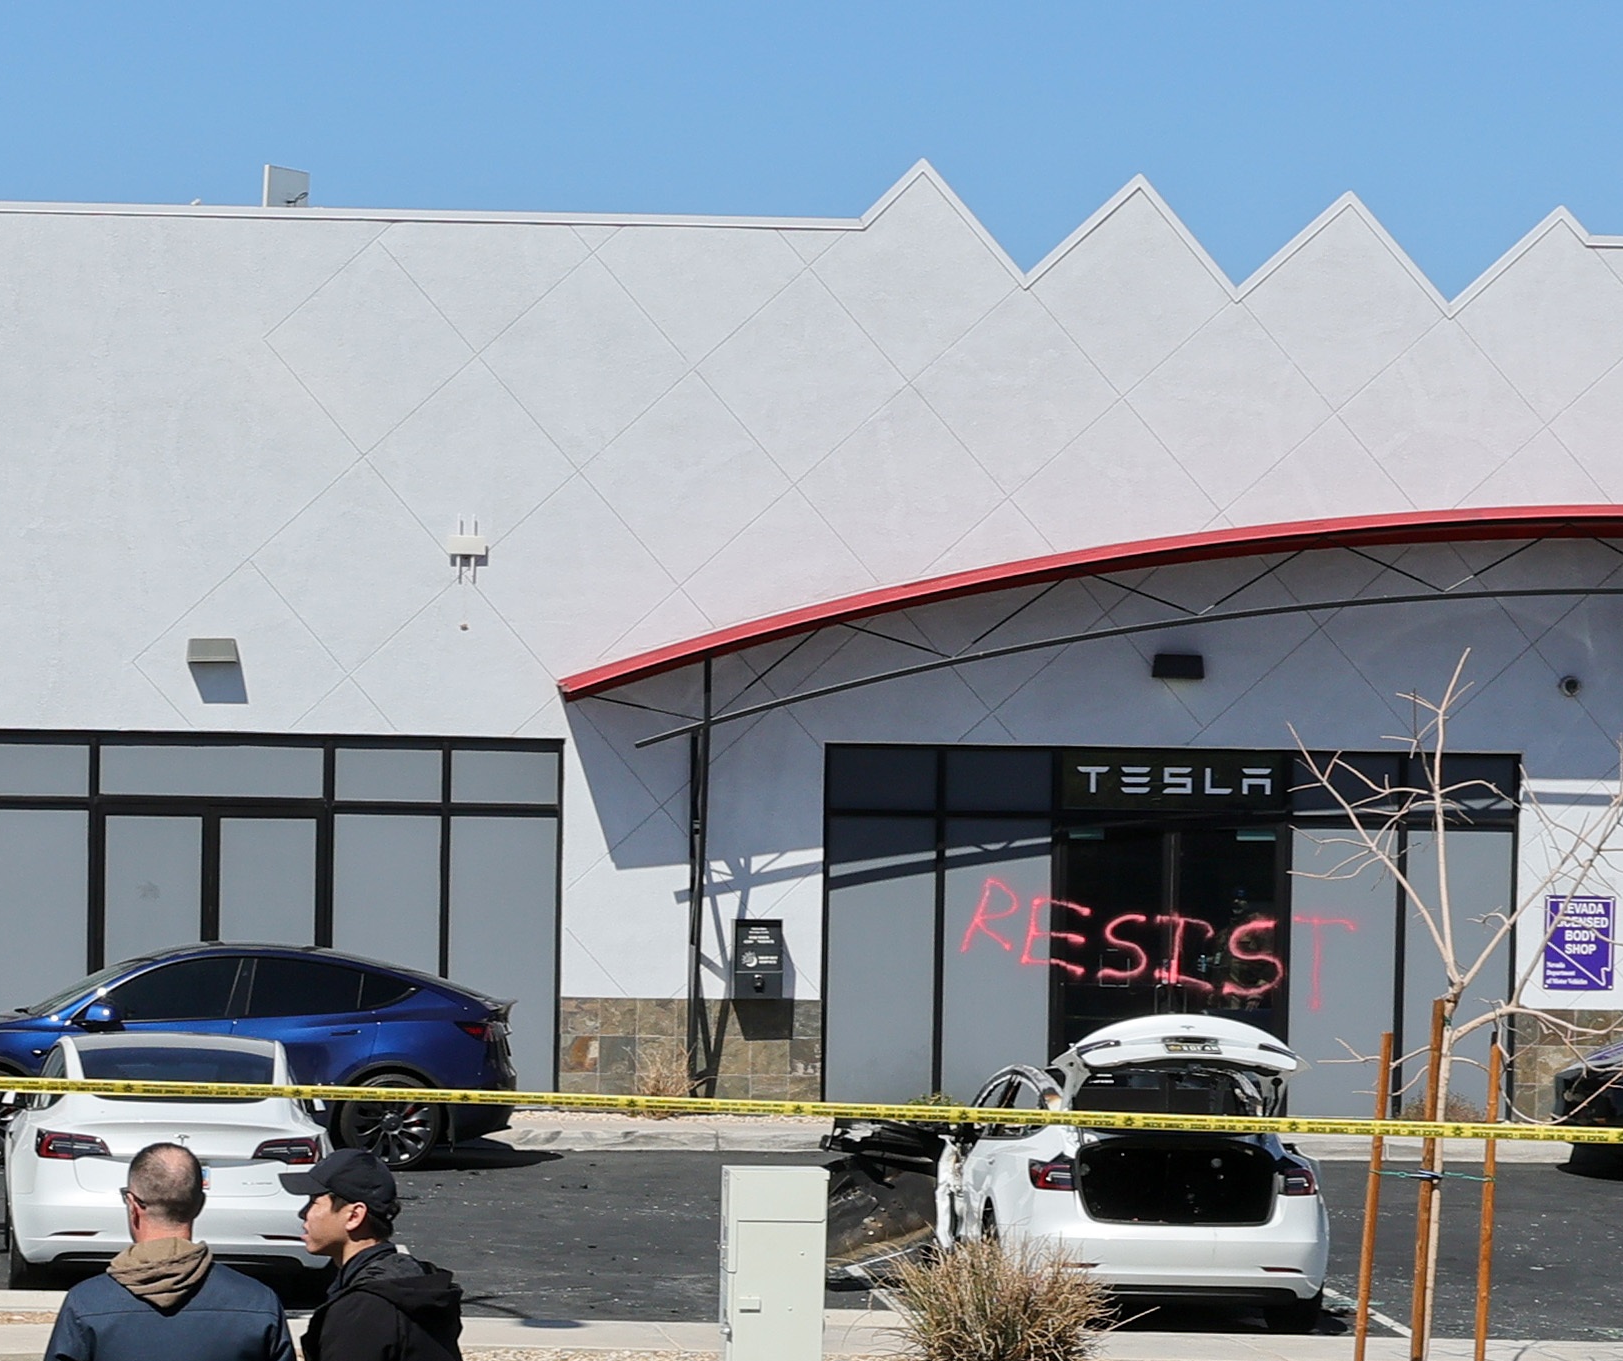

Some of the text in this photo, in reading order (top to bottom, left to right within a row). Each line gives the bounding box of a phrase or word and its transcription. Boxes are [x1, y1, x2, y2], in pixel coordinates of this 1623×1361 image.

[1077, 766, 1272, 795] TESLA
[959, 876, 1357, 1012] RESIST
[1564, 930, 1597, 942] BODY
[1564, 944, 1597, 955] SHOP
